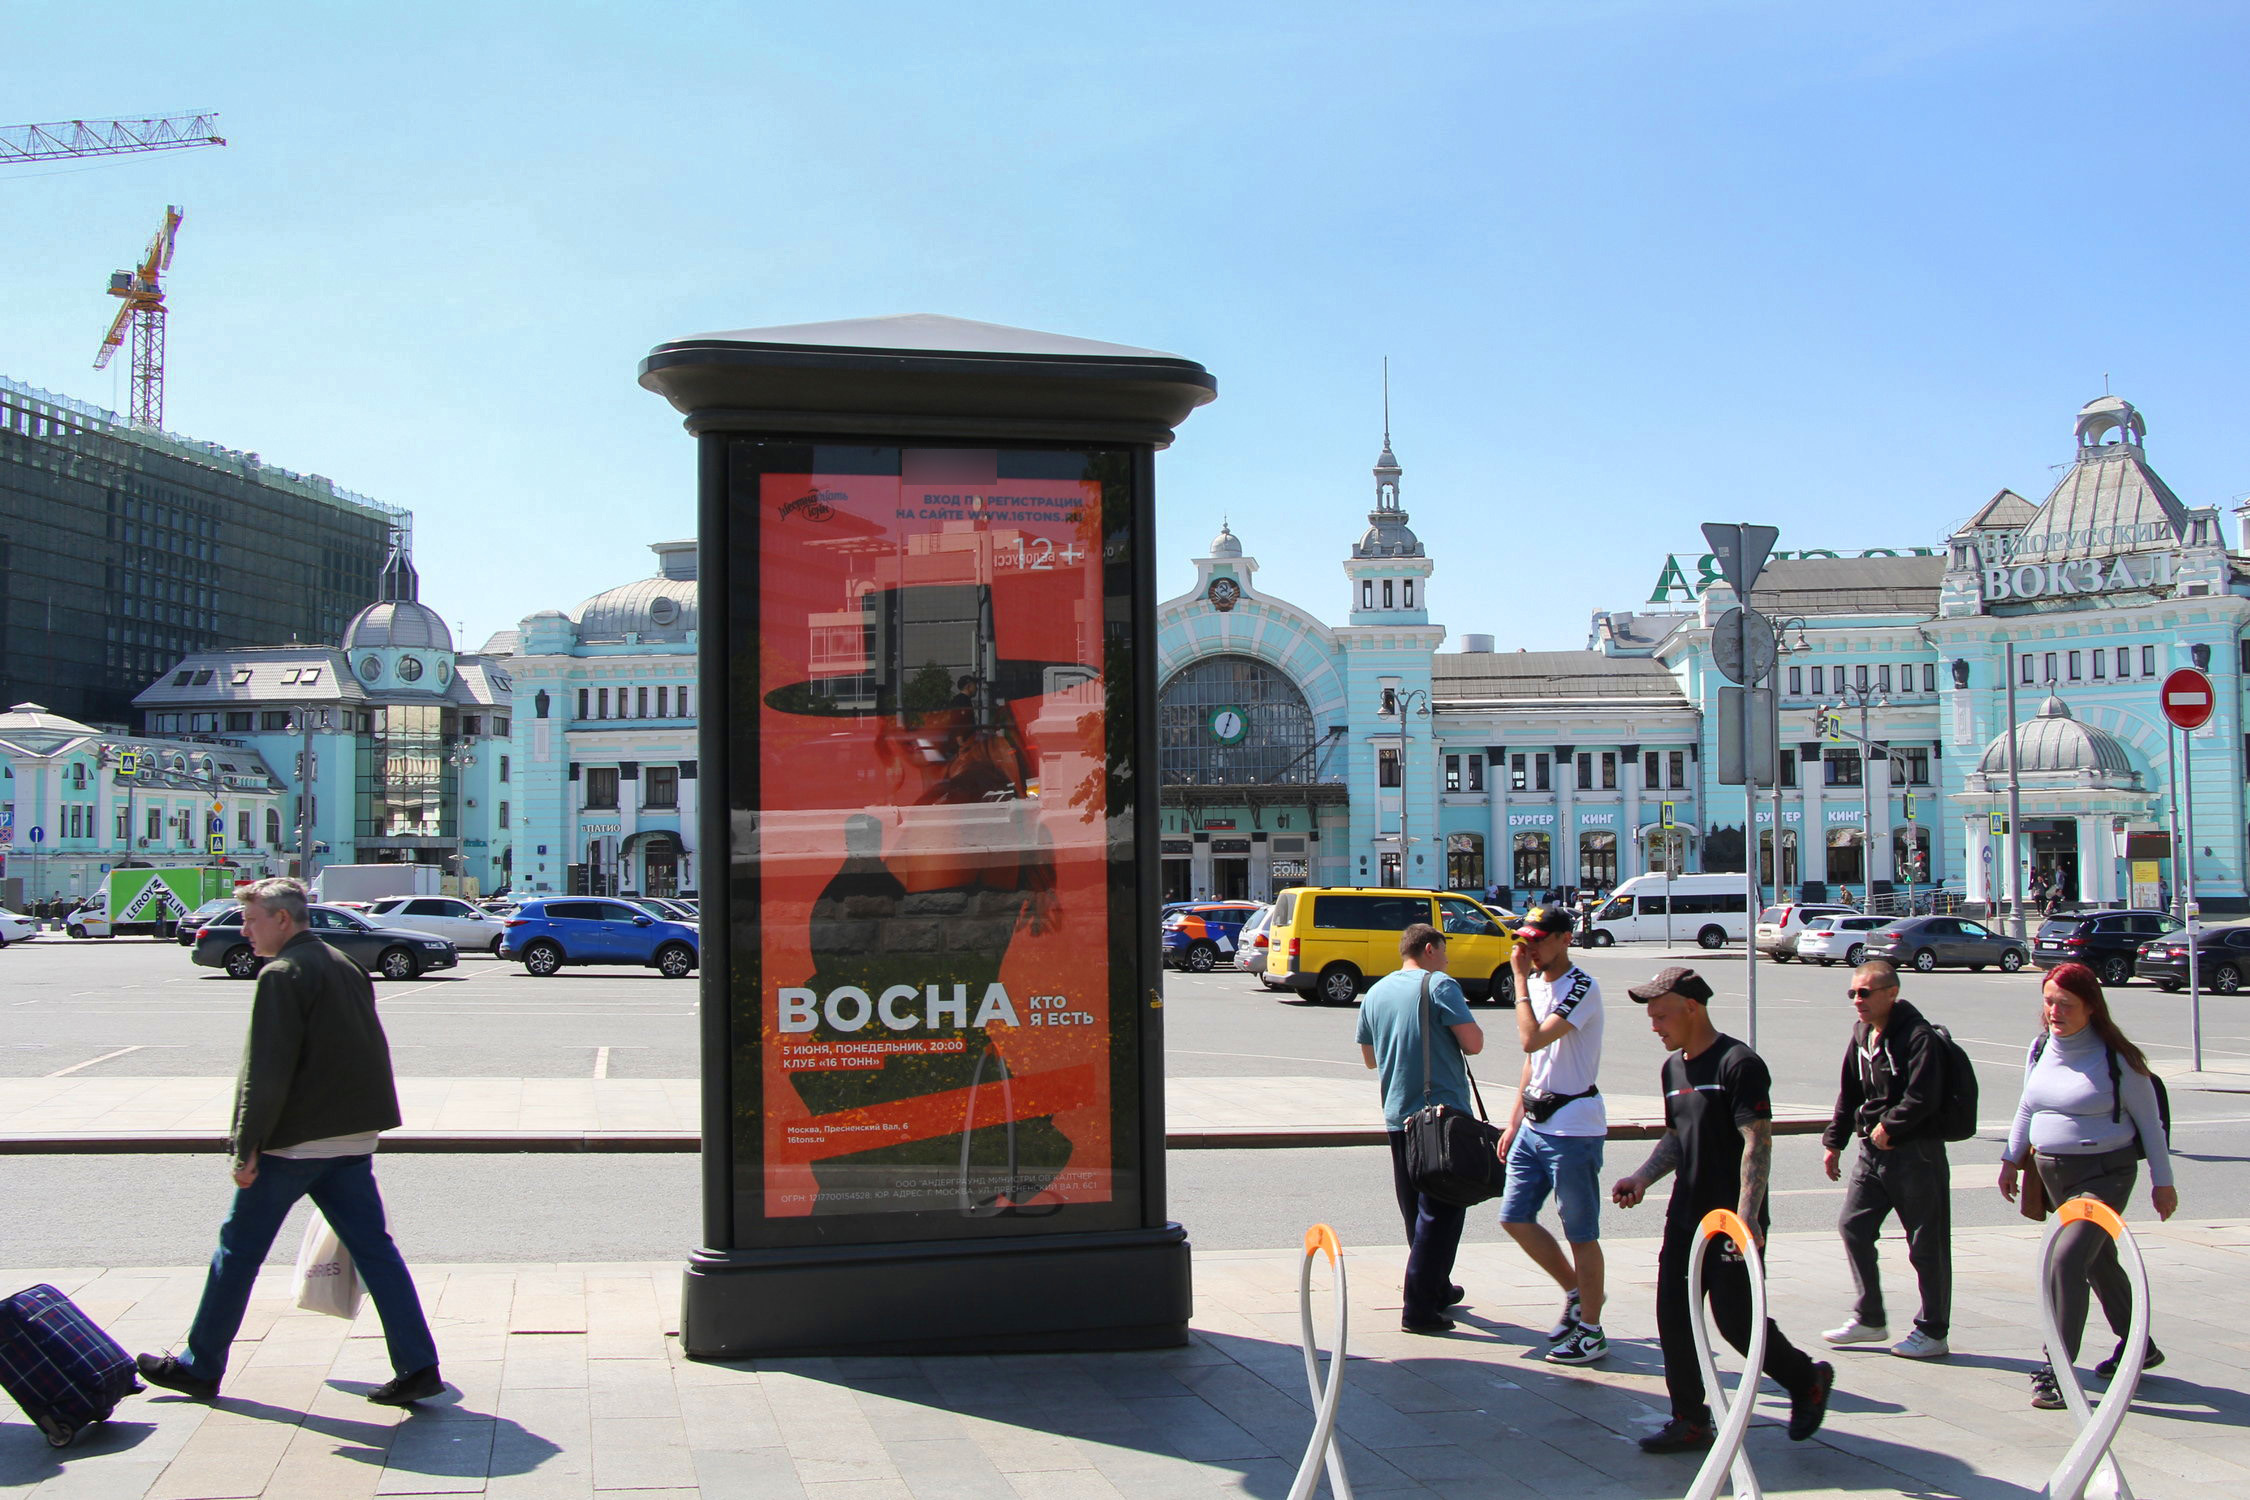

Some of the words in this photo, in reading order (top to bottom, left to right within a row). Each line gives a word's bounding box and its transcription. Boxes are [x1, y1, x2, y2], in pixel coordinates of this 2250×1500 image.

[924, 495, 960, 506] ВХОД
[988, 496, 1082, 508] РЕГИСТРАЦИИ
[896, 509, 915, 520] НА
[920, 508, 963, 521] САЙТЕ
[1983, 514, 2173, 560] БЕЛОРУССКИЙ
[1012, 537, 1082, 570] 12+
[1982, 551, 2177, 600] ВОКЗАЛ
[1509, 814, 1554, 826] БУРГЕР
[1581, 813, 1614, 825] КИНГ
[1828, 810, 1861, 822] КИНГ
[587, 824, 621, 833] ПАТИО
[126, 886, 154, 919] LEROY
[151, 879, 186, 918] MRLIN
[778, 982, 1020, 1033] ВОСНА
[1029, 996, 1066, 1009] КТО
[1029, 1014, 1042, 1026] Я
[1048, 1012, 1094, 1025] ЕСТЬ
[783, 1046, 790, 1055] 5
[793, 1044, 832, 1056] ИЮНЯ,
[836, 1042, 926, 1054] ПОНЕДЕЛЬНИК,
[930, 1041, 963, 1051] 20:00
[783, 1058, 815, 1069] КЛУБ
[819, 1058, 837, 1067] «16
[841, 1057, 880, 1067] ТОНН»
[824, 1124, 881, 1134] Пресненский
[882, 1123, 901, 1131] Вал,
[902, 1122, 909, 1130] 6
[787, 1136, 825, 1144] 16tons.ru
[895, 1179, 917, 1188] ООО
[988, 1175, 1036, 1186] МИНИСТРИ
